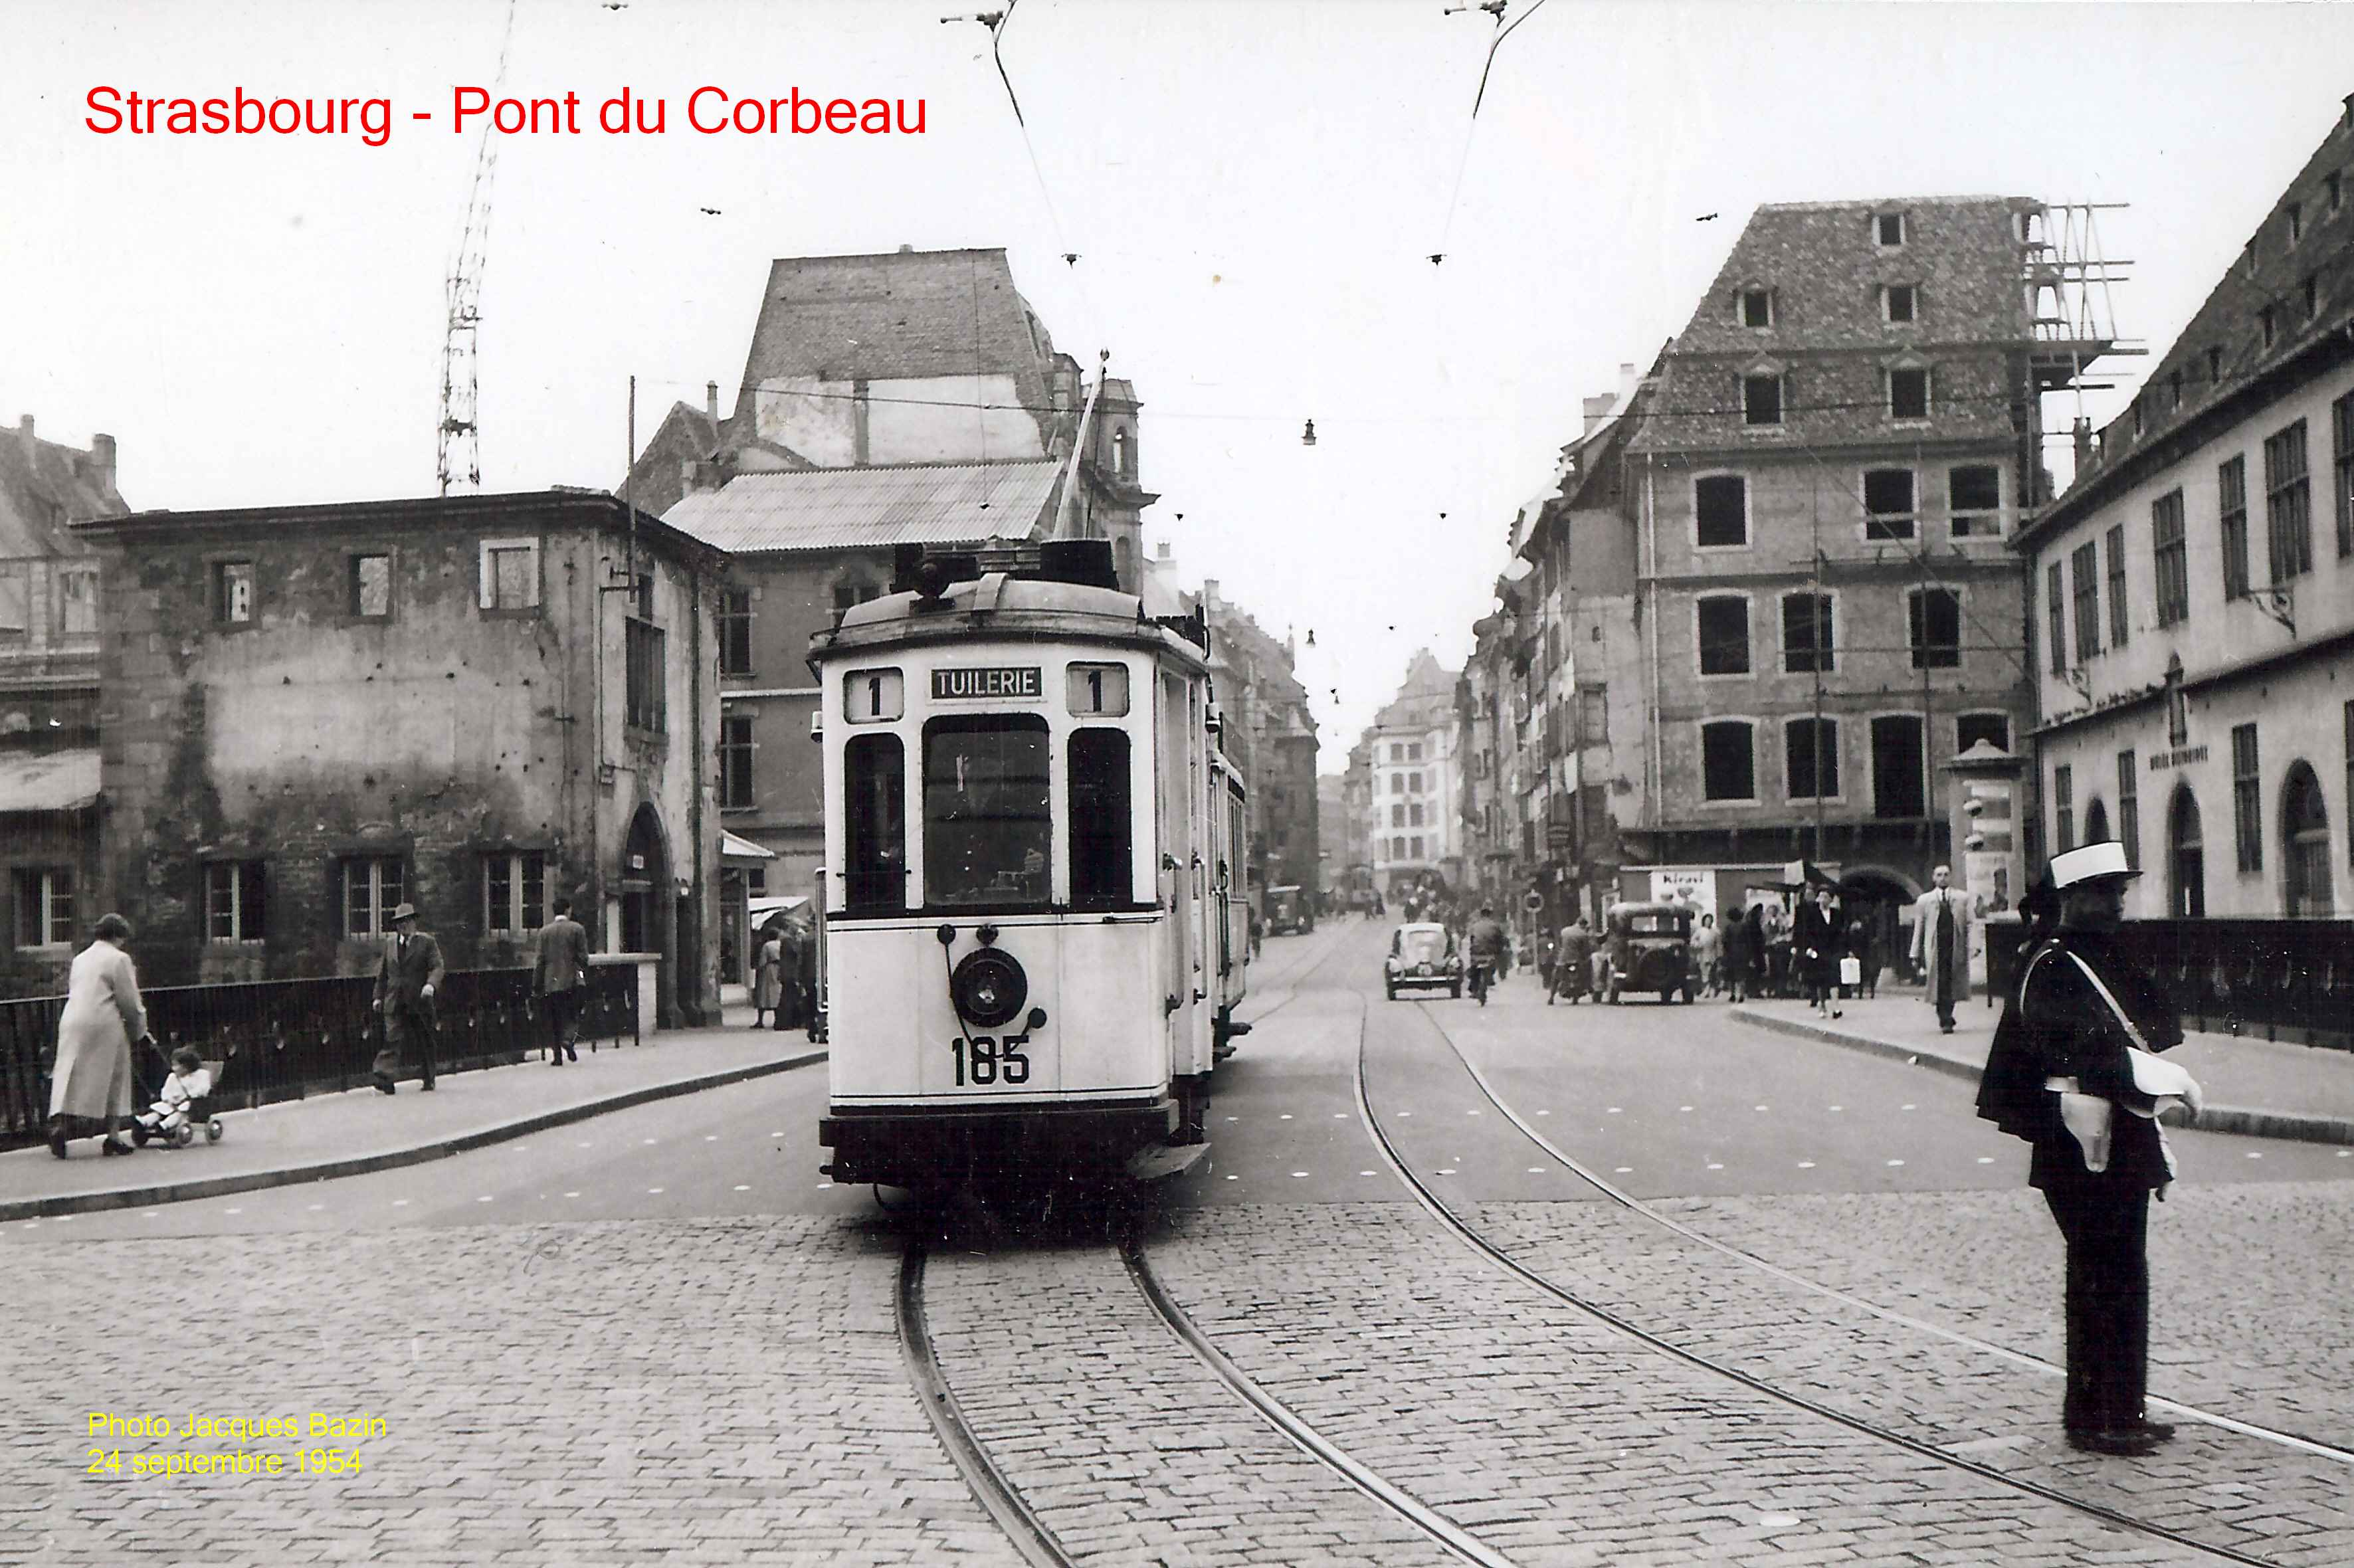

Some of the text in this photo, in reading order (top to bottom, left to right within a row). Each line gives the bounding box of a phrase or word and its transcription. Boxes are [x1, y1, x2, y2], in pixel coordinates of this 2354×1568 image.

[868, 678, 881, 716] 1
[937, 670, 1035, 696] TUILERIE
[1088, 670, 1102, 712] 1
[952, 1035, 1029, 1086] 185
